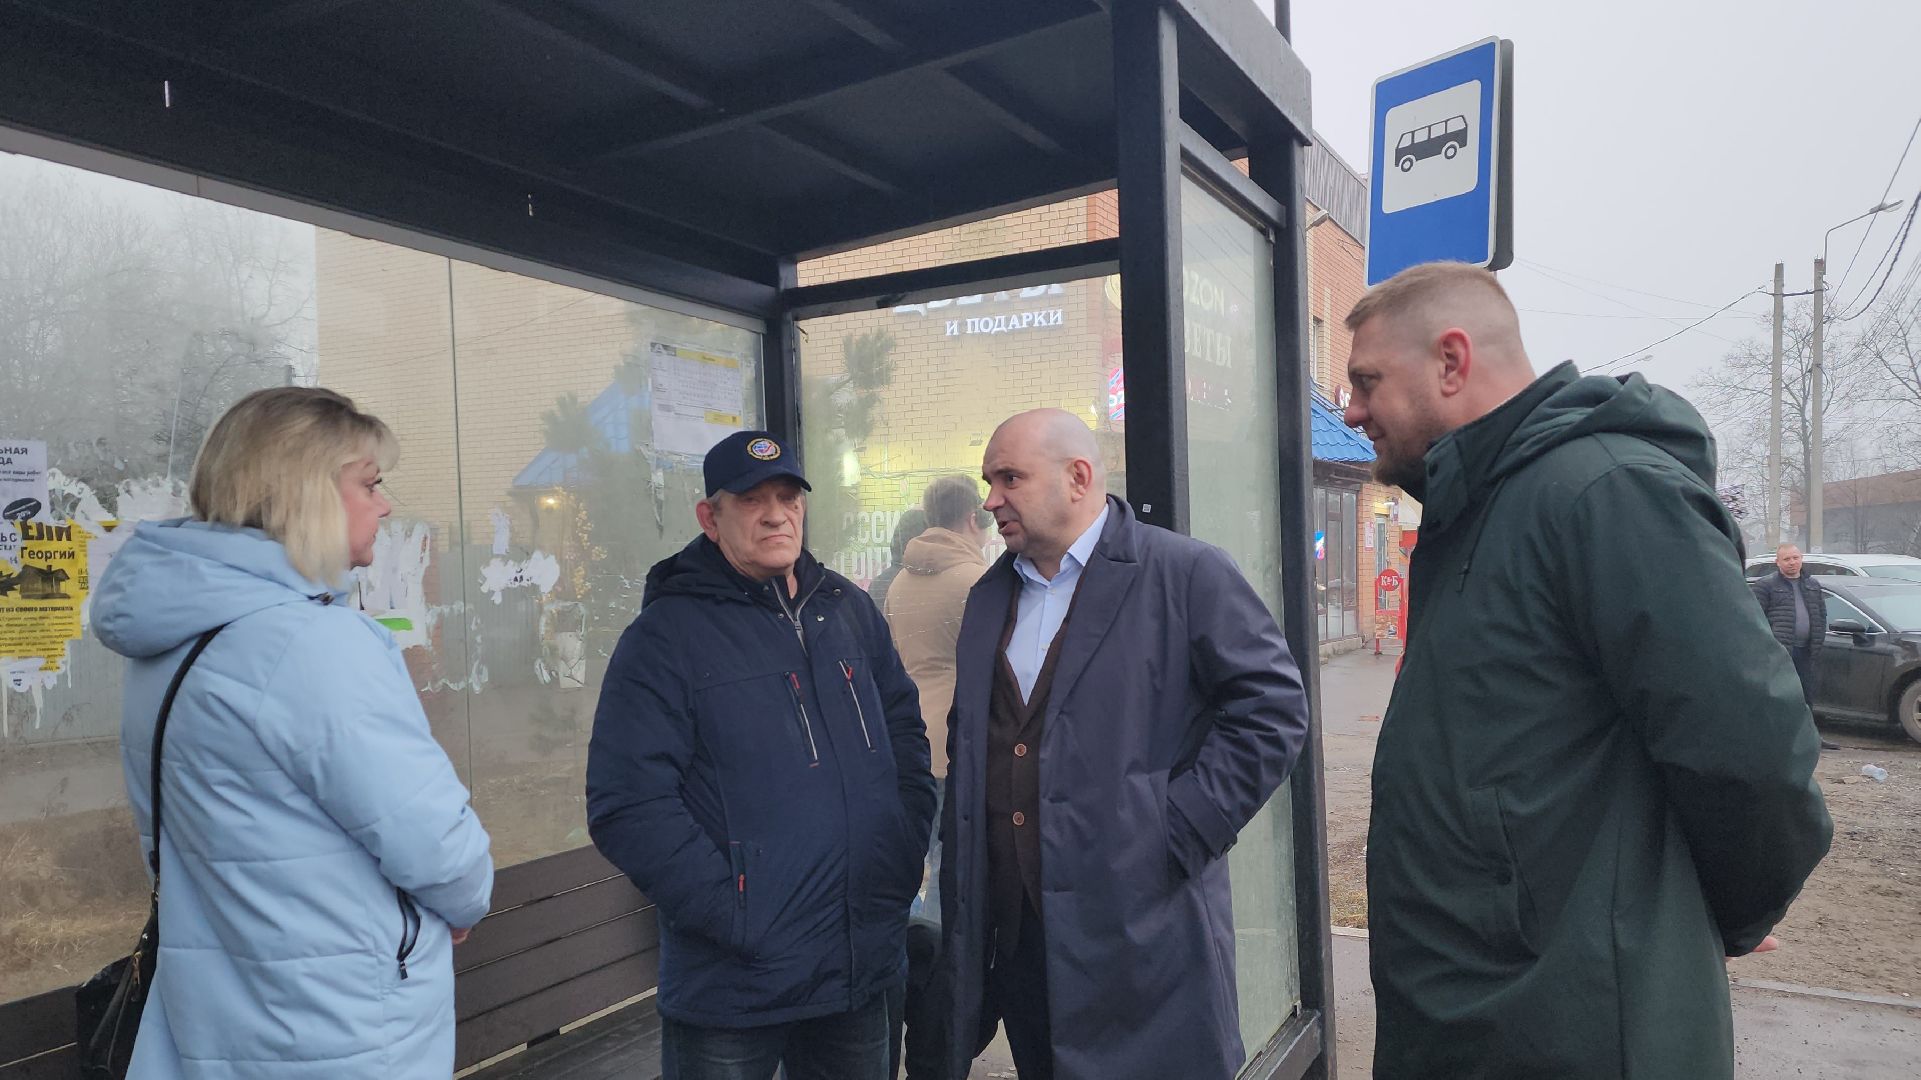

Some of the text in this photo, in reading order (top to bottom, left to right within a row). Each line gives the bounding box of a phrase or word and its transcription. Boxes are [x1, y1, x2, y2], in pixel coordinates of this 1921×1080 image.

[945, 309, 1064, 336] И ПОДАРКИ
[20, 547, 75, 562] Георгий
